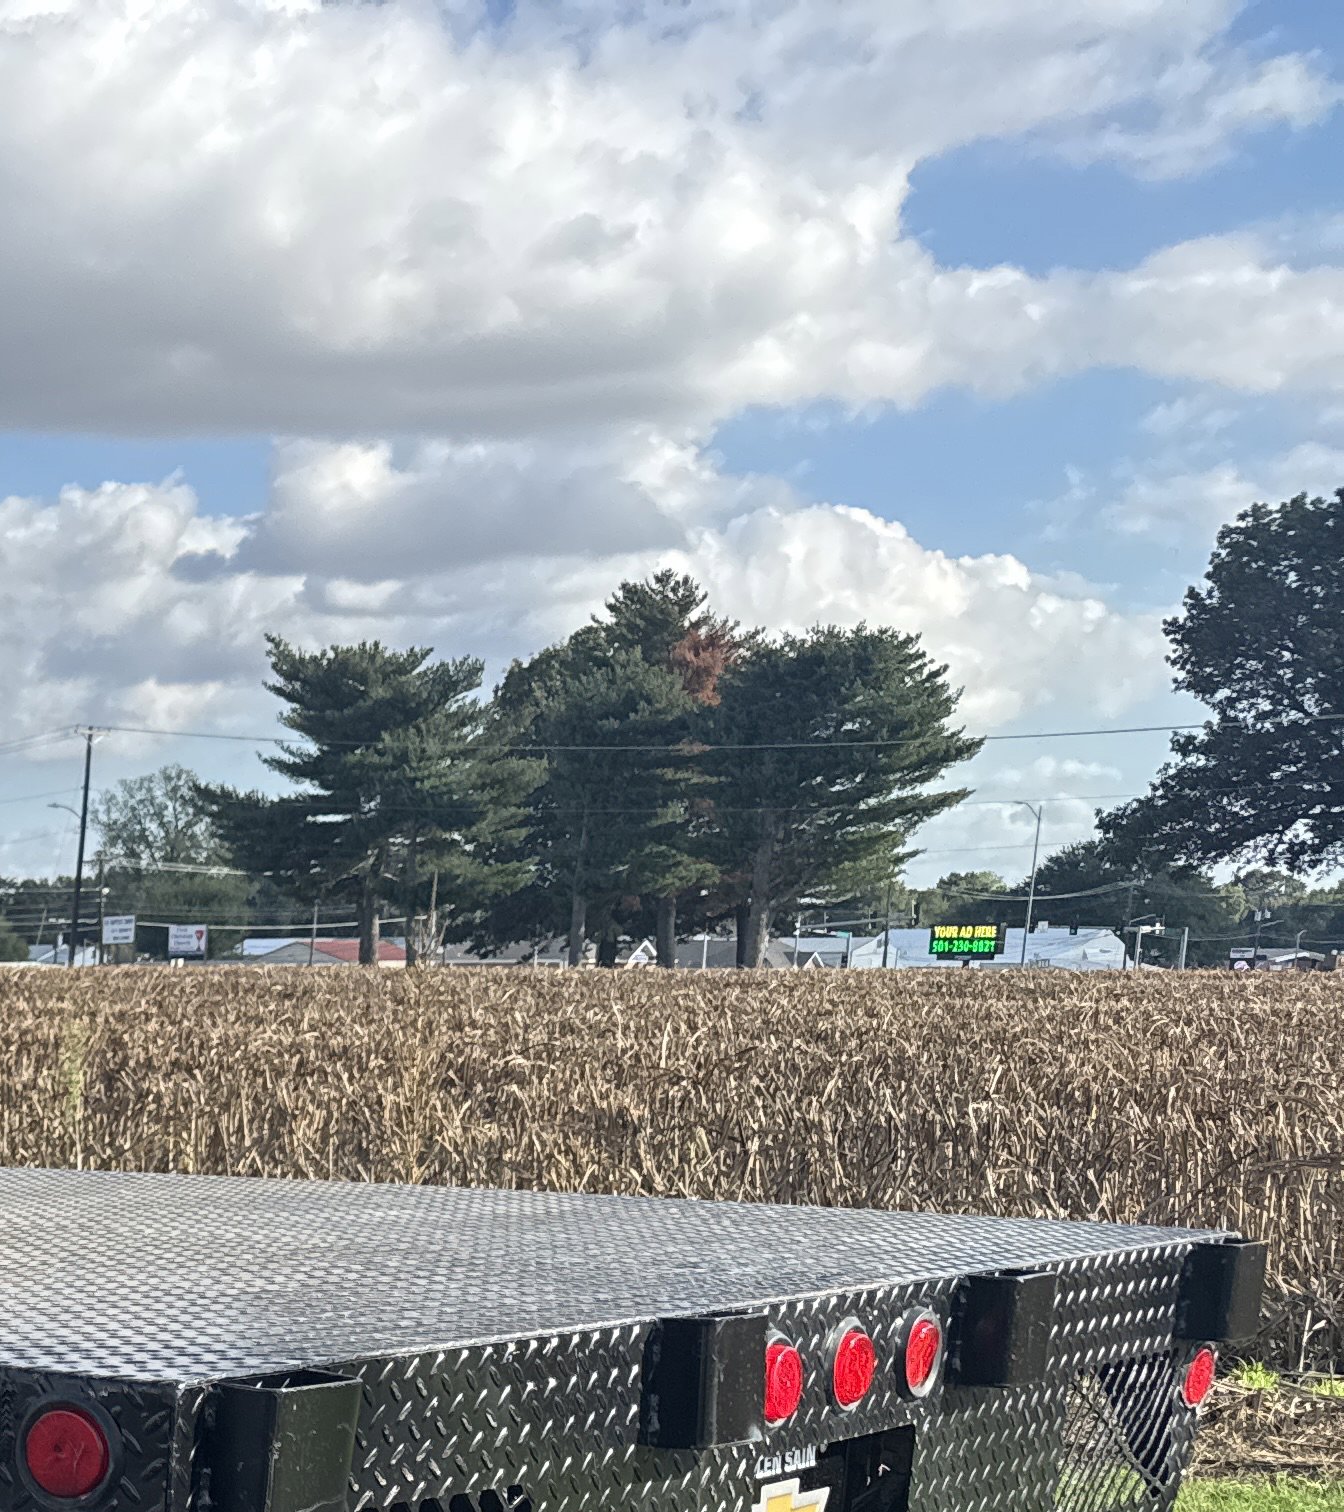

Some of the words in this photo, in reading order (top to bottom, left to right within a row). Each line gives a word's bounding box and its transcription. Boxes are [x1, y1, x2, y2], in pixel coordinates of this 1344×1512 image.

[934, 925, 959, 938] YOUR
[959, 925, 973, 938] AD
[974, 925, 997, 938] HERE
[753, 1454, 782, 1479] LEN
[784, 1444, 816, 1473] SAIN
